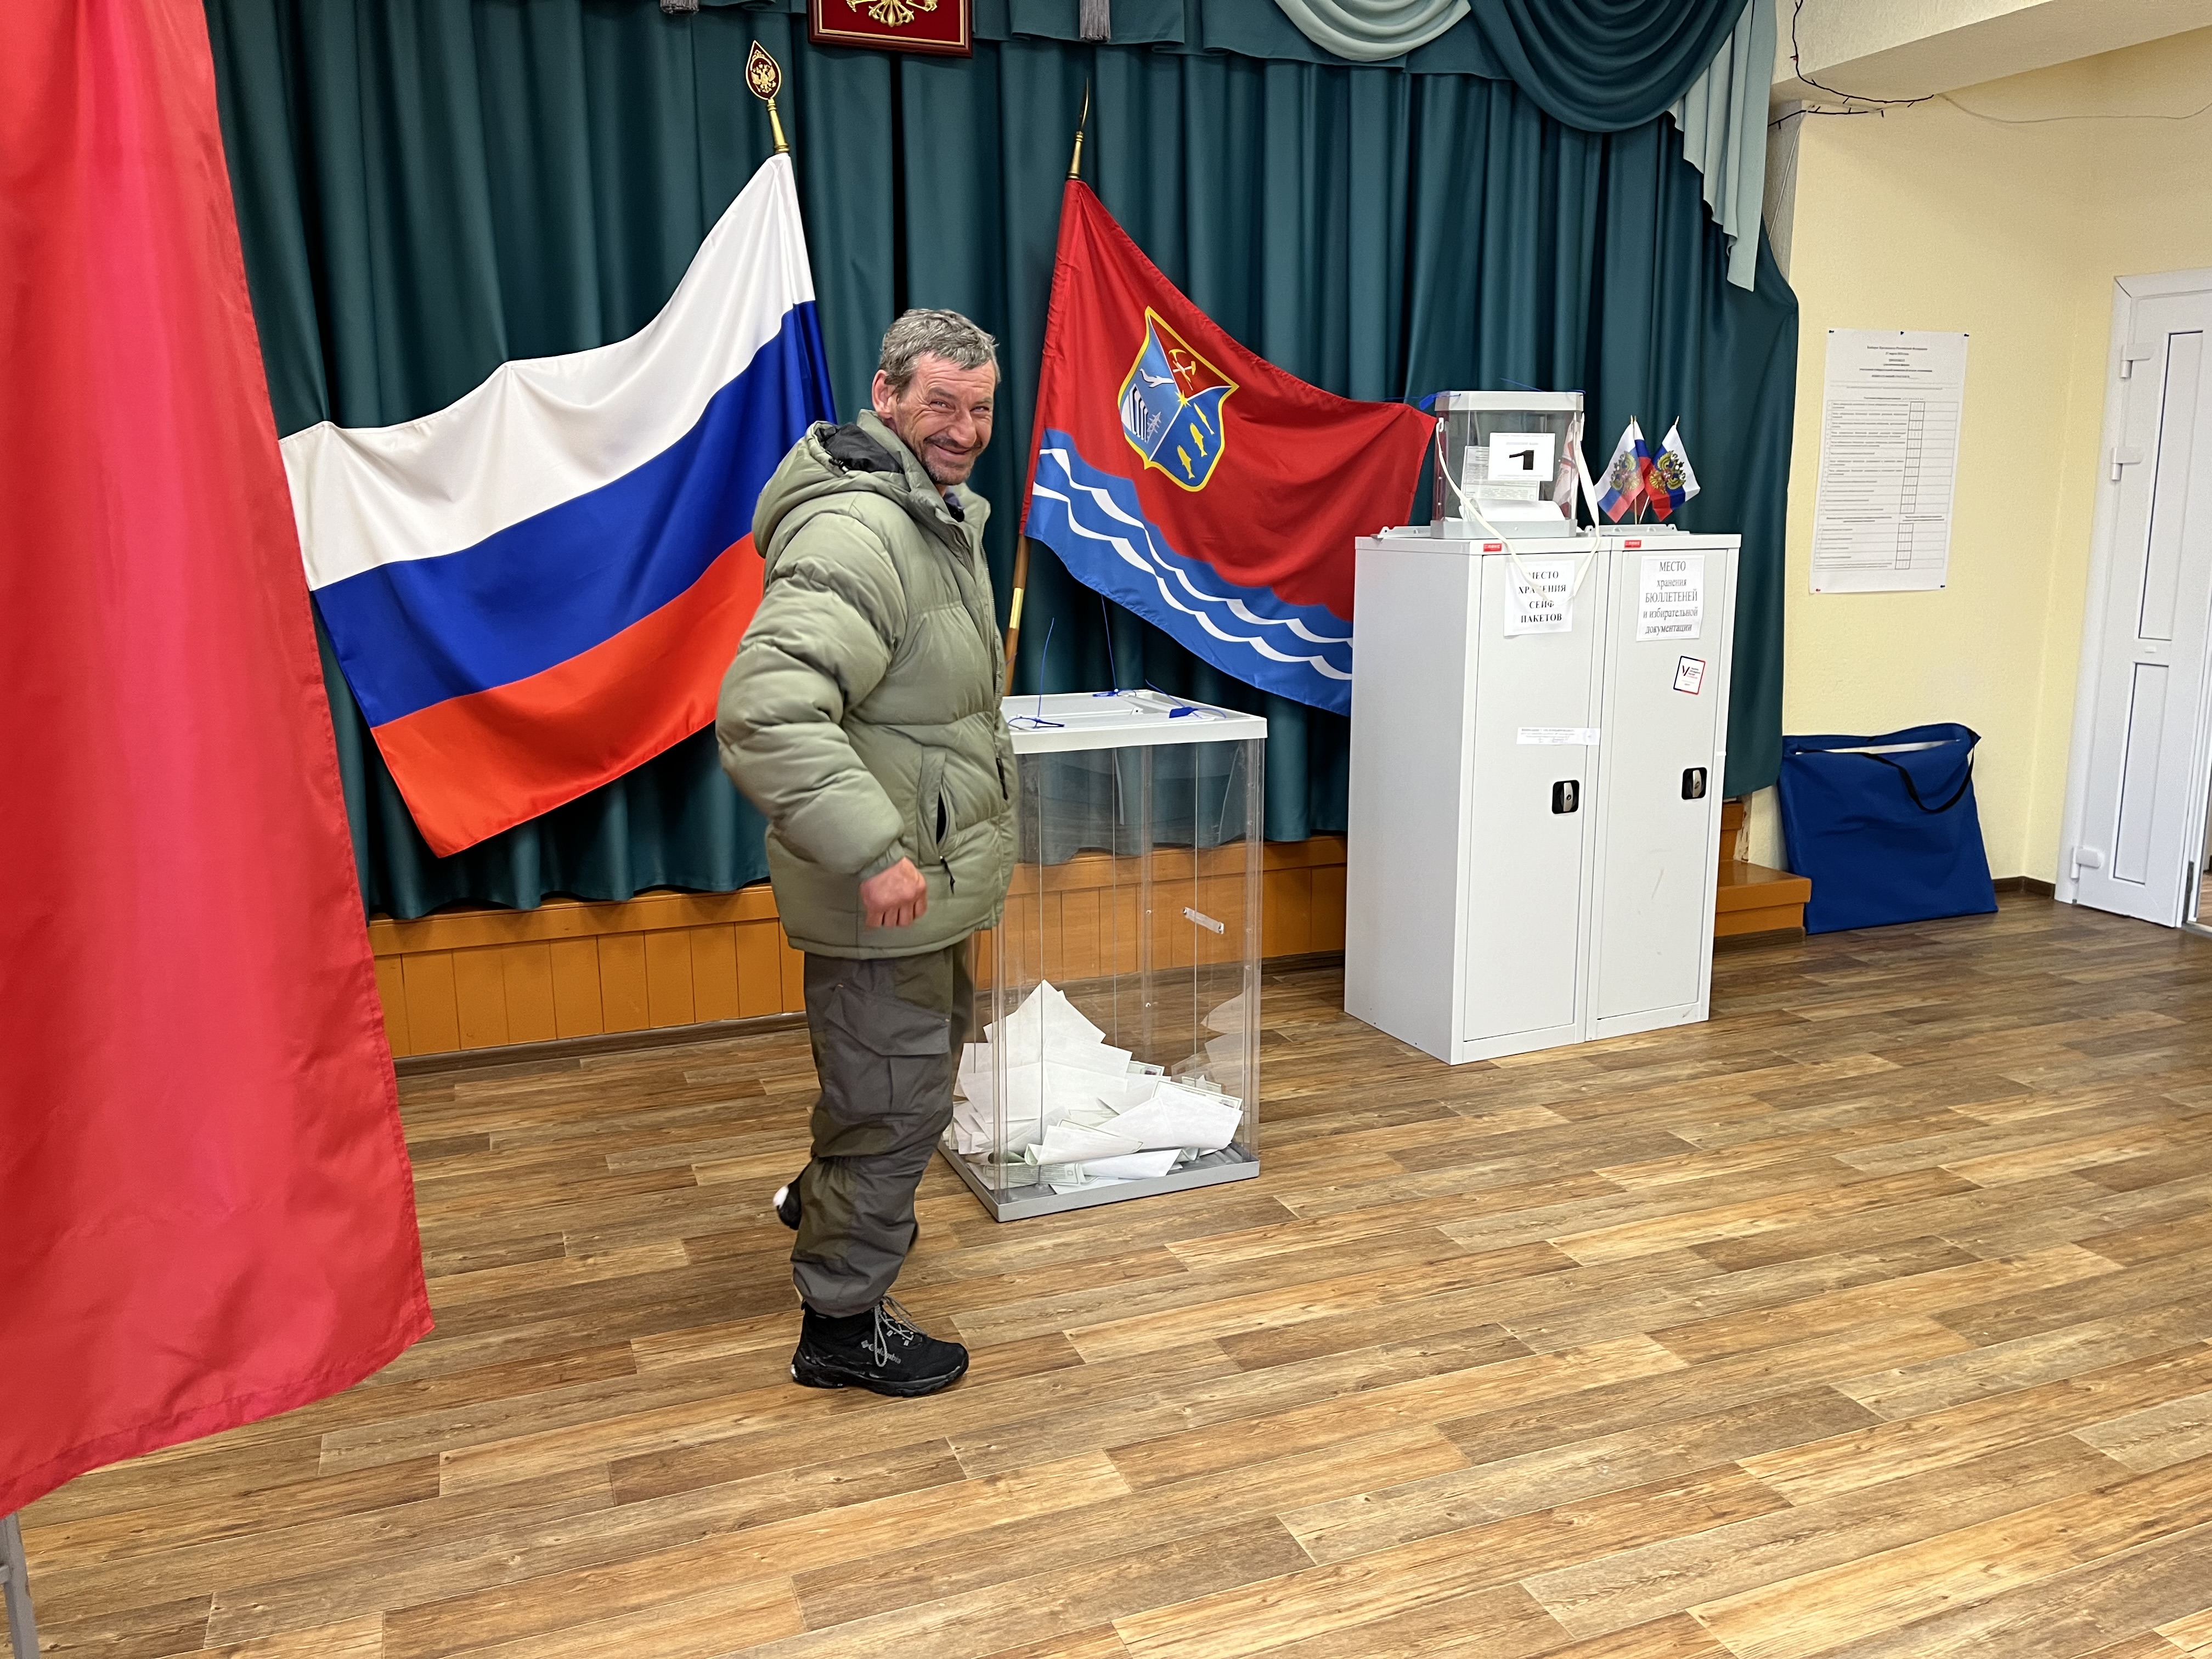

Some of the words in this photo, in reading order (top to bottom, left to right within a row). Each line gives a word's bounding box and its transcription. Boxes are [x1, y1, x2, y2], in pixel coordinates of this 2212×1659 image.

[1509, 449, 1534, 470] 1
[1659, 561, 1686, 572] МЕСТО
[1518, 584, 1566, 594] ХРАЕНИЯ
[1657, 579, 1687, 590] хранения
[1645, 588, 1698, 603] БЮЛЛЕТЕНЕЙ
[1521, 613, 1562, 623] ПАКЕТОВ
[1649, 606, 1698, 620] избирательной
[1645, 624, 1692, 635] документации
